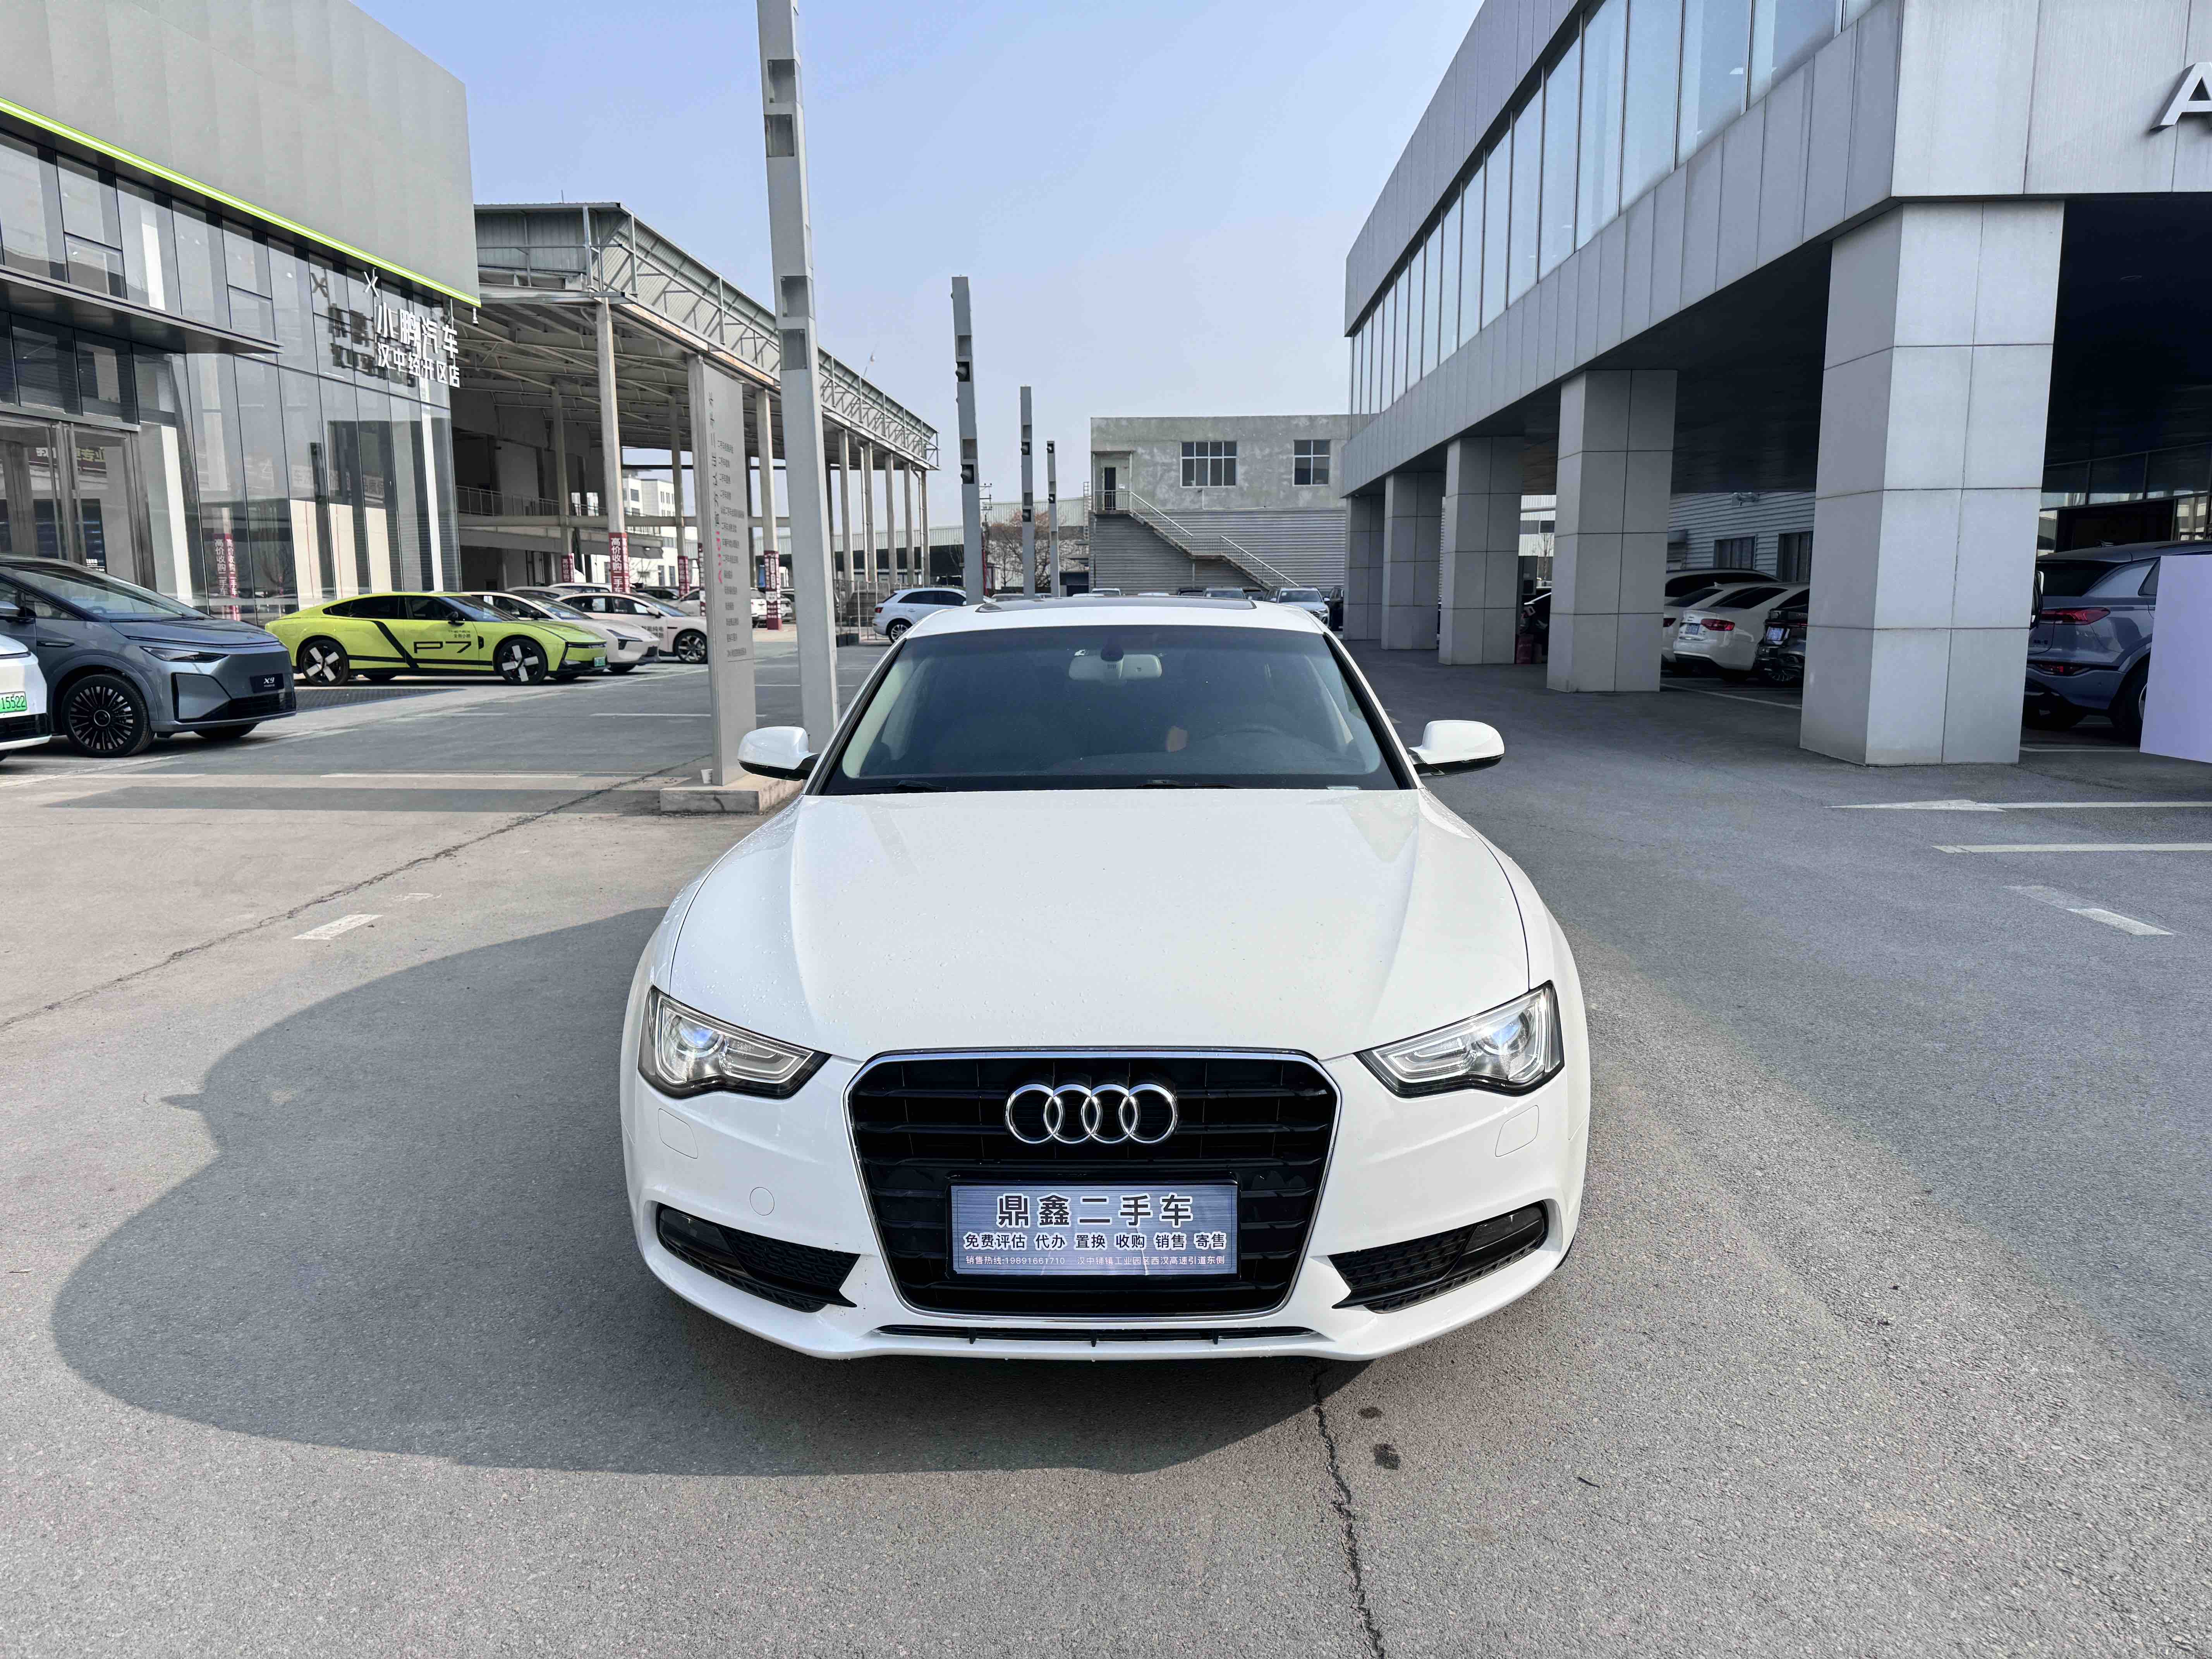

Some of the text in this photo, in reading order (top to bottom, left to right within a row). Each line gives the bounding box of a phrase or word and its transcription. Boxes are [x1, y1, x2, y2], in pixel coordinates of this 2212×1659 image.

[377, 302, 459, 359] 小鹏汽车
[378, 342, 460, 388] 汉中经开区店
[215, 539, 229, 595] 高价收购二手车
[226, 539, 239, 595] 高价收购二手车
[611, 538, 623, 592] 高价收购二手车
[414, 641, 472, 653] P7
[1, 696, 26, 709] 15522
[998, 1194, 1192, 1228] 鼎鑫二手车
[965, 1233, 1225, 1249] 免费评估 代办 置换 收购 销售 寄售
[966, 1255, 1225, 1265] 销售热线:19891661710 汉中铺镇工业园区西汉高速引道东侧
